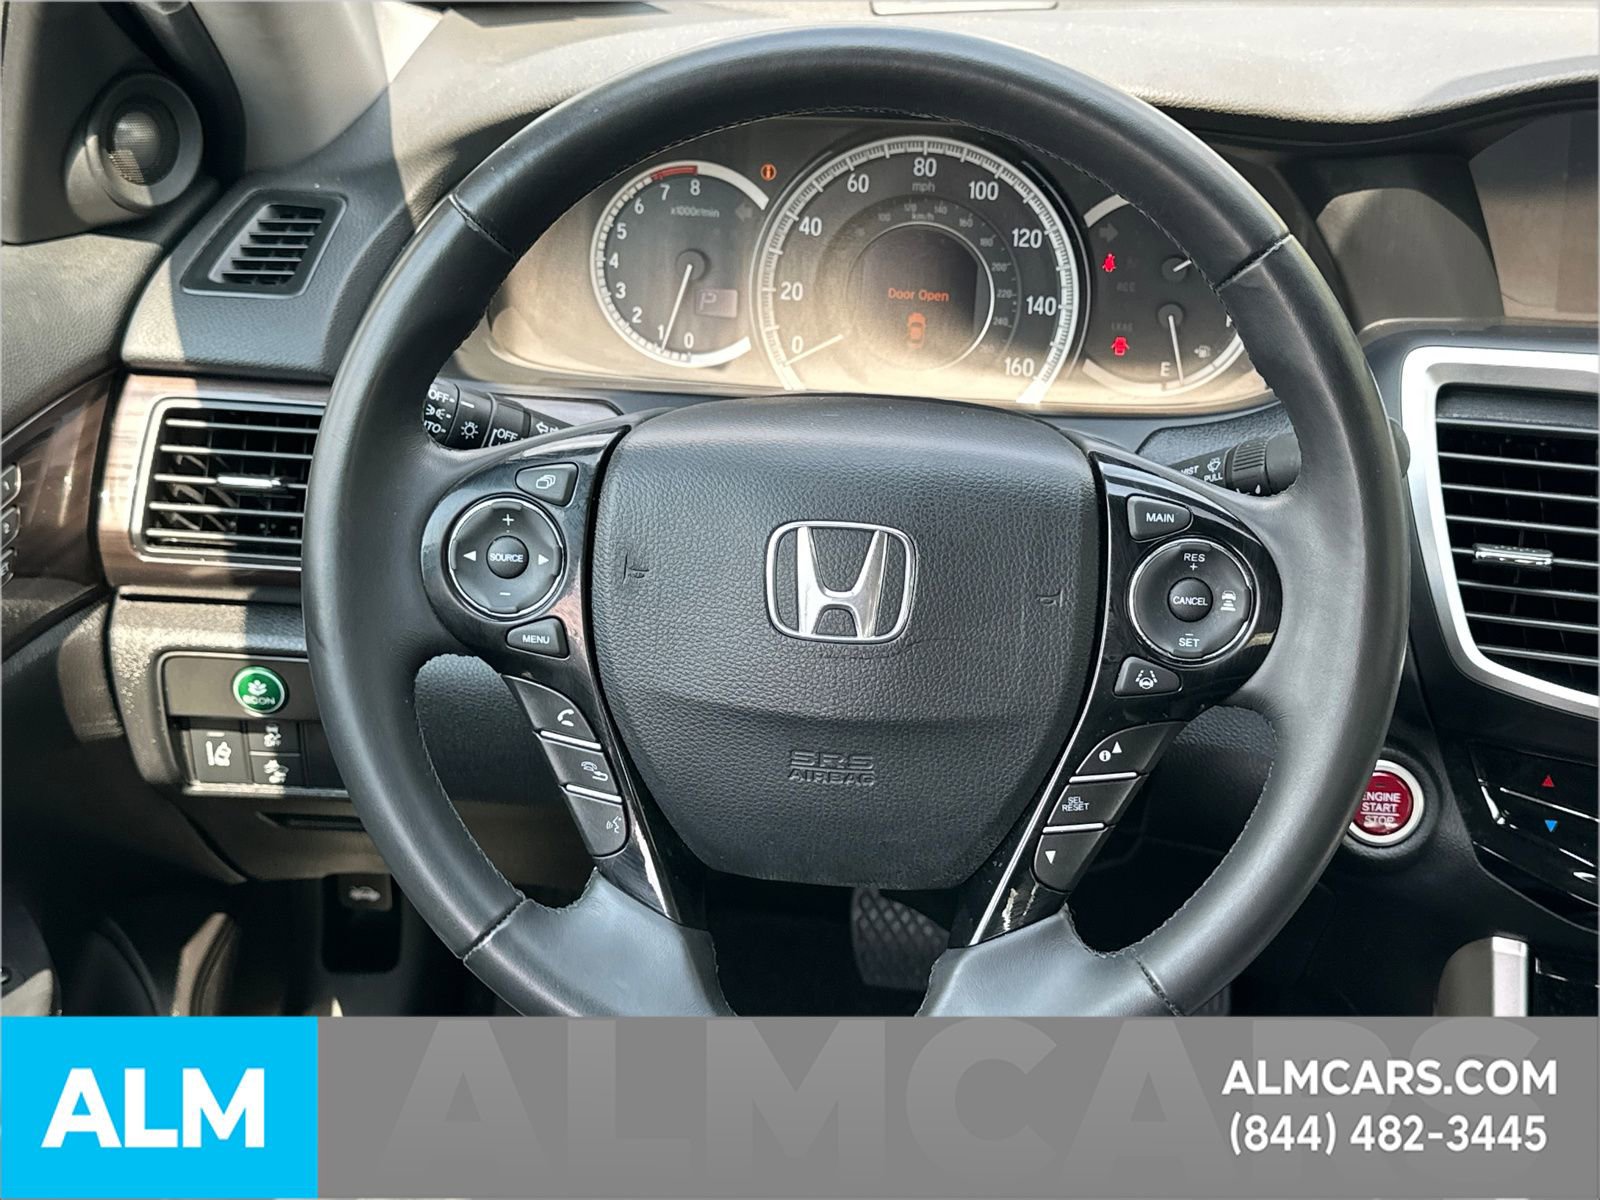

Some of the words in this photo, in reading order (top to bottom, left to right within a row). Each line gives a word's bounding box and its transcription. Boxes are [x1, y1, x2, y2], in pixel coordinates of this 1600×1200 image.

[913, 157, 937, 177] 80
[660, 183, 671, 200] 7
[690, 179, 700, 196] 8
[847, 174, 869, 193] 60
[912, 182, 935, 194] mph
[968, 181, 999, 200] 100
[634, 197, 645, 214] 6
[617, 223, 627, 239] 5
[799, 217, 822, 236] 40
[1012, 228, 1042, 248] 120
[609, 252, 619, 269] 4
[616, 282, 626, 299] 3
[780, 282, 803, 300] 20
[888, 288, 914, 301] Door
[918, 290, 949, 303] Open
[1026, 296, 1056, 316] 140
[632, 307, 643, 323] 2
[657, 325, 664, 340] 1
[683, 332, 694, 349] 0
[791, 335, 804, 354] 0
[1005, 357, 1035, 377] 160
[1160, 361, 1171, 377] E
[428, 389, 450, 403] OFF
[497, 428, 518, 441] OFF
[1204, 472, 1224, 482] PULL
[1146, 512, 1175, 523] MAIN
[489, 554, 524, 563] SOURCE
[1183, 553, 1205, 563] RES
[1172, 595, 1208, 606] CANCEL
[522, 634, 550, 644] MENU
[1178, 637, 1200, 648] SET
[242, 695, 276, 705] ECON
[789, 750, 874, 769] SRS
[788, 768, 875, 786] AIRBAG
[1062, 802, 1090, 812] RESET
[1067, 796, 1084, 804] SEL
[1361, 802, 1398, 813] START
[1364, 815, 1395, 825] STOP
